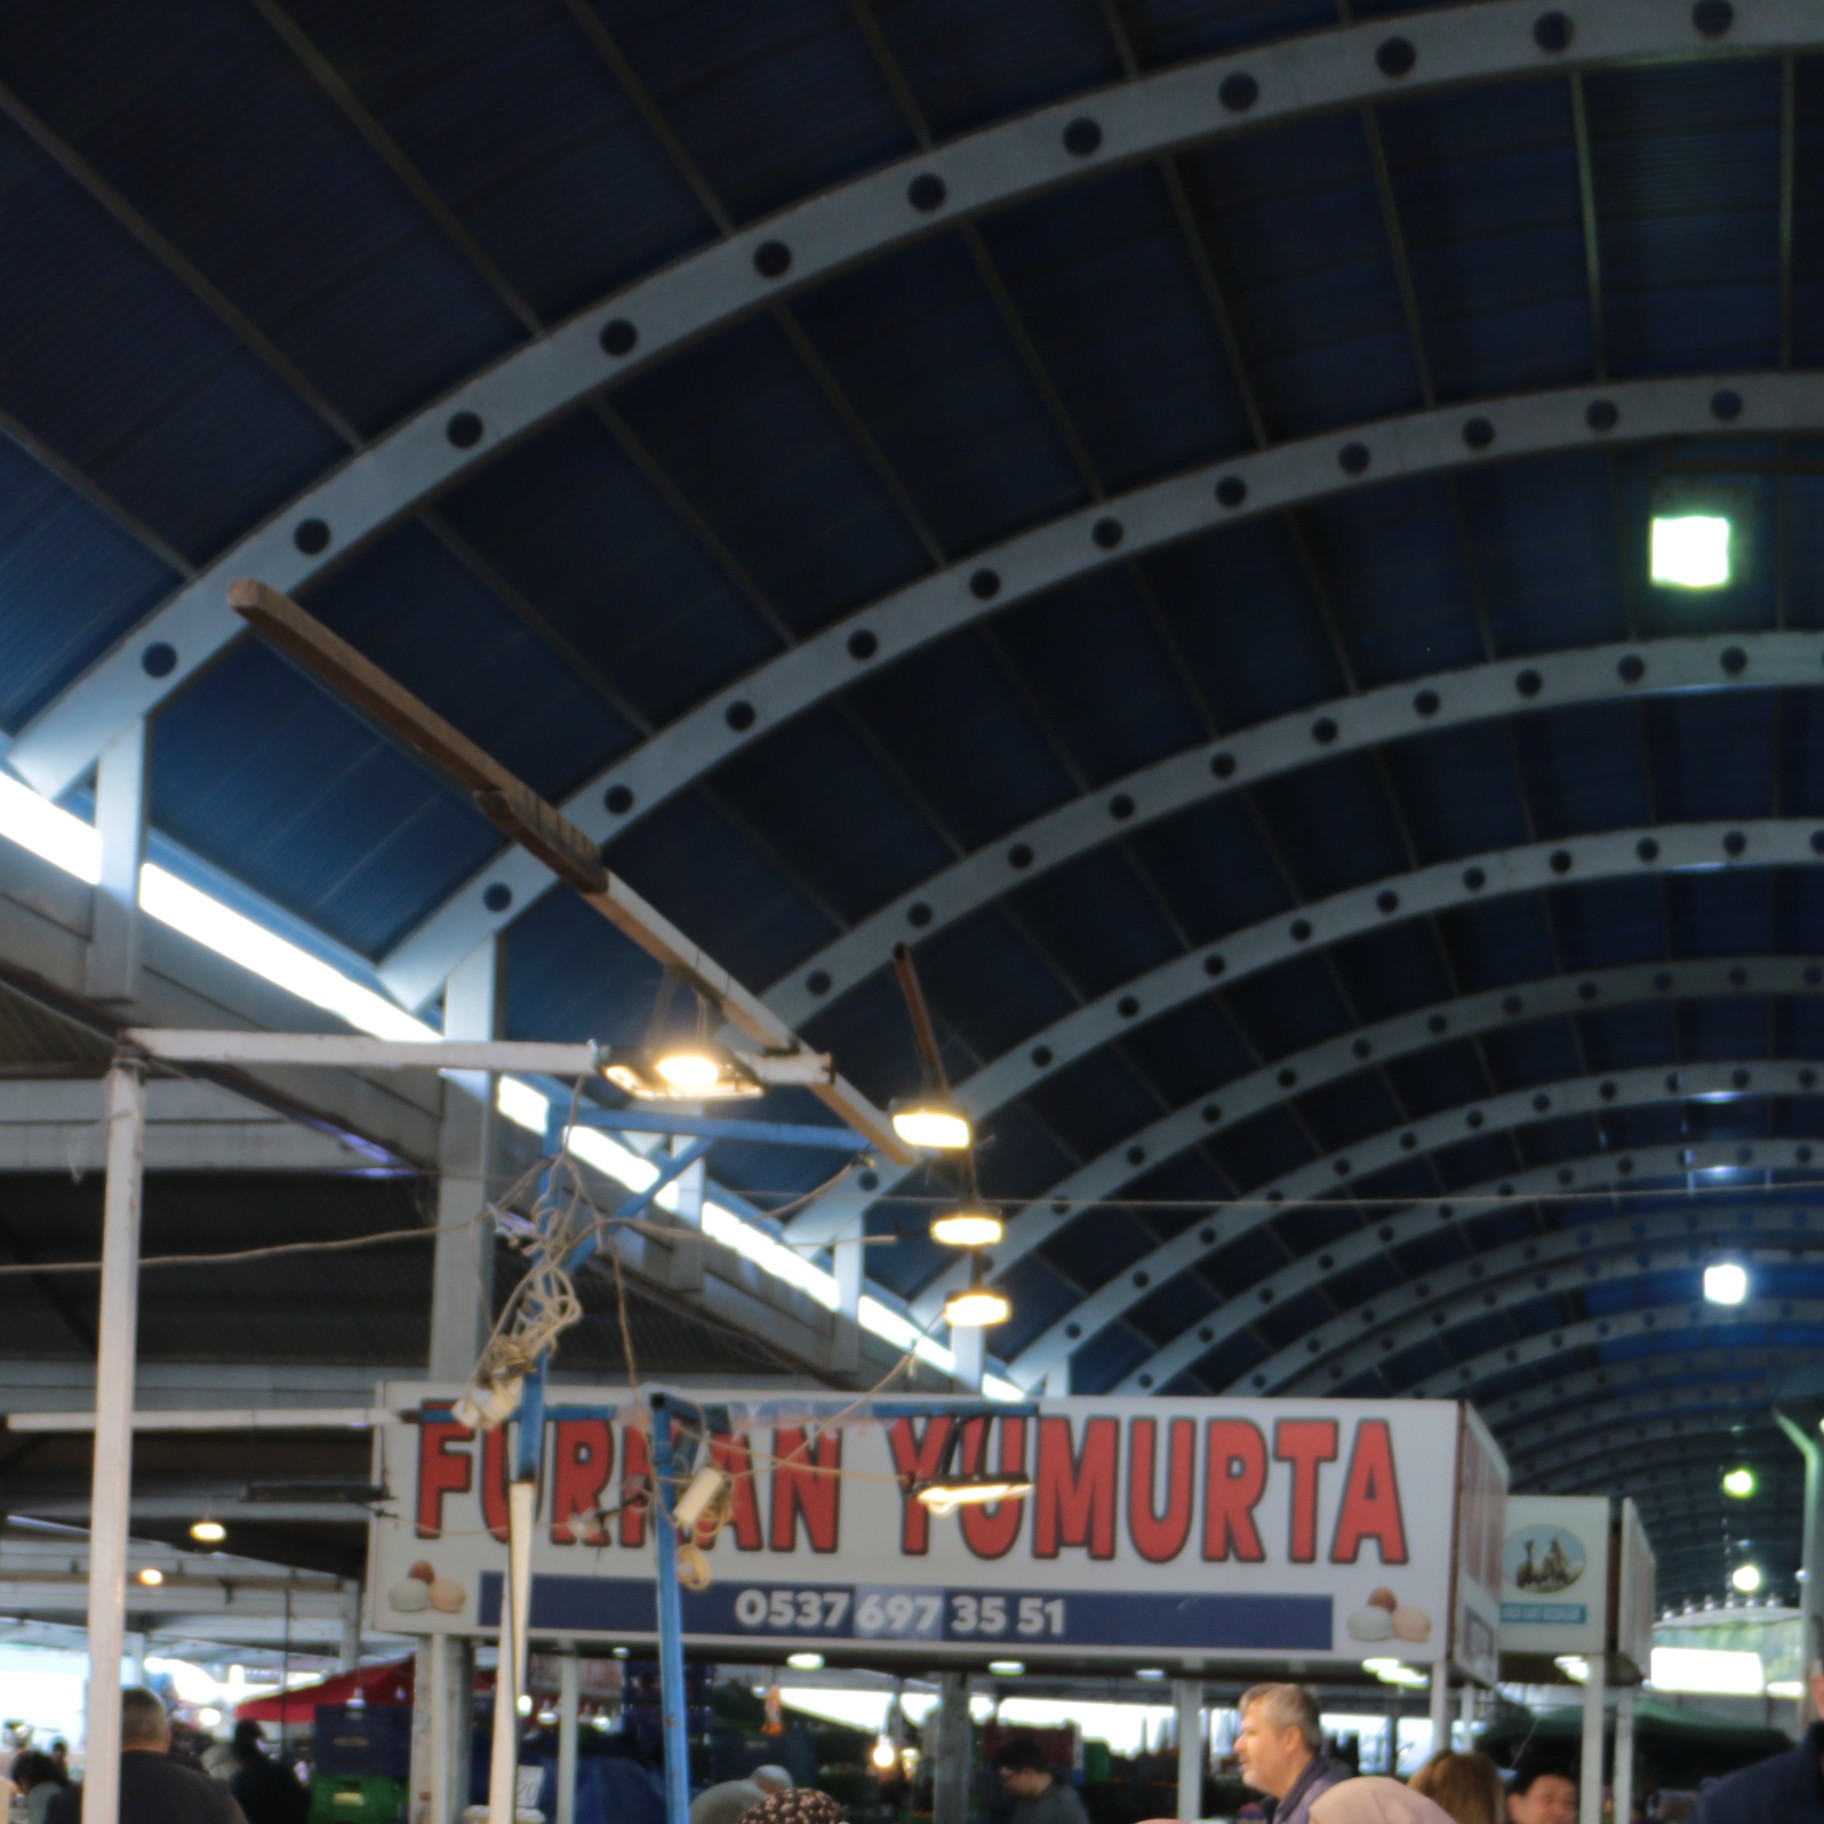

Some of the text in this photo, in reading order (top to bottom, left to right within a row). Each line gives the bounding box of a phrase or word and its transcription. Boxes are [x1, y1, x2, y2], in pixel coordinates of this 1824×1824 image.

[888, 1415, 1410, 1567] YUMURTA
[734, 1588, 1067, 1636] 0537 697 35 51
